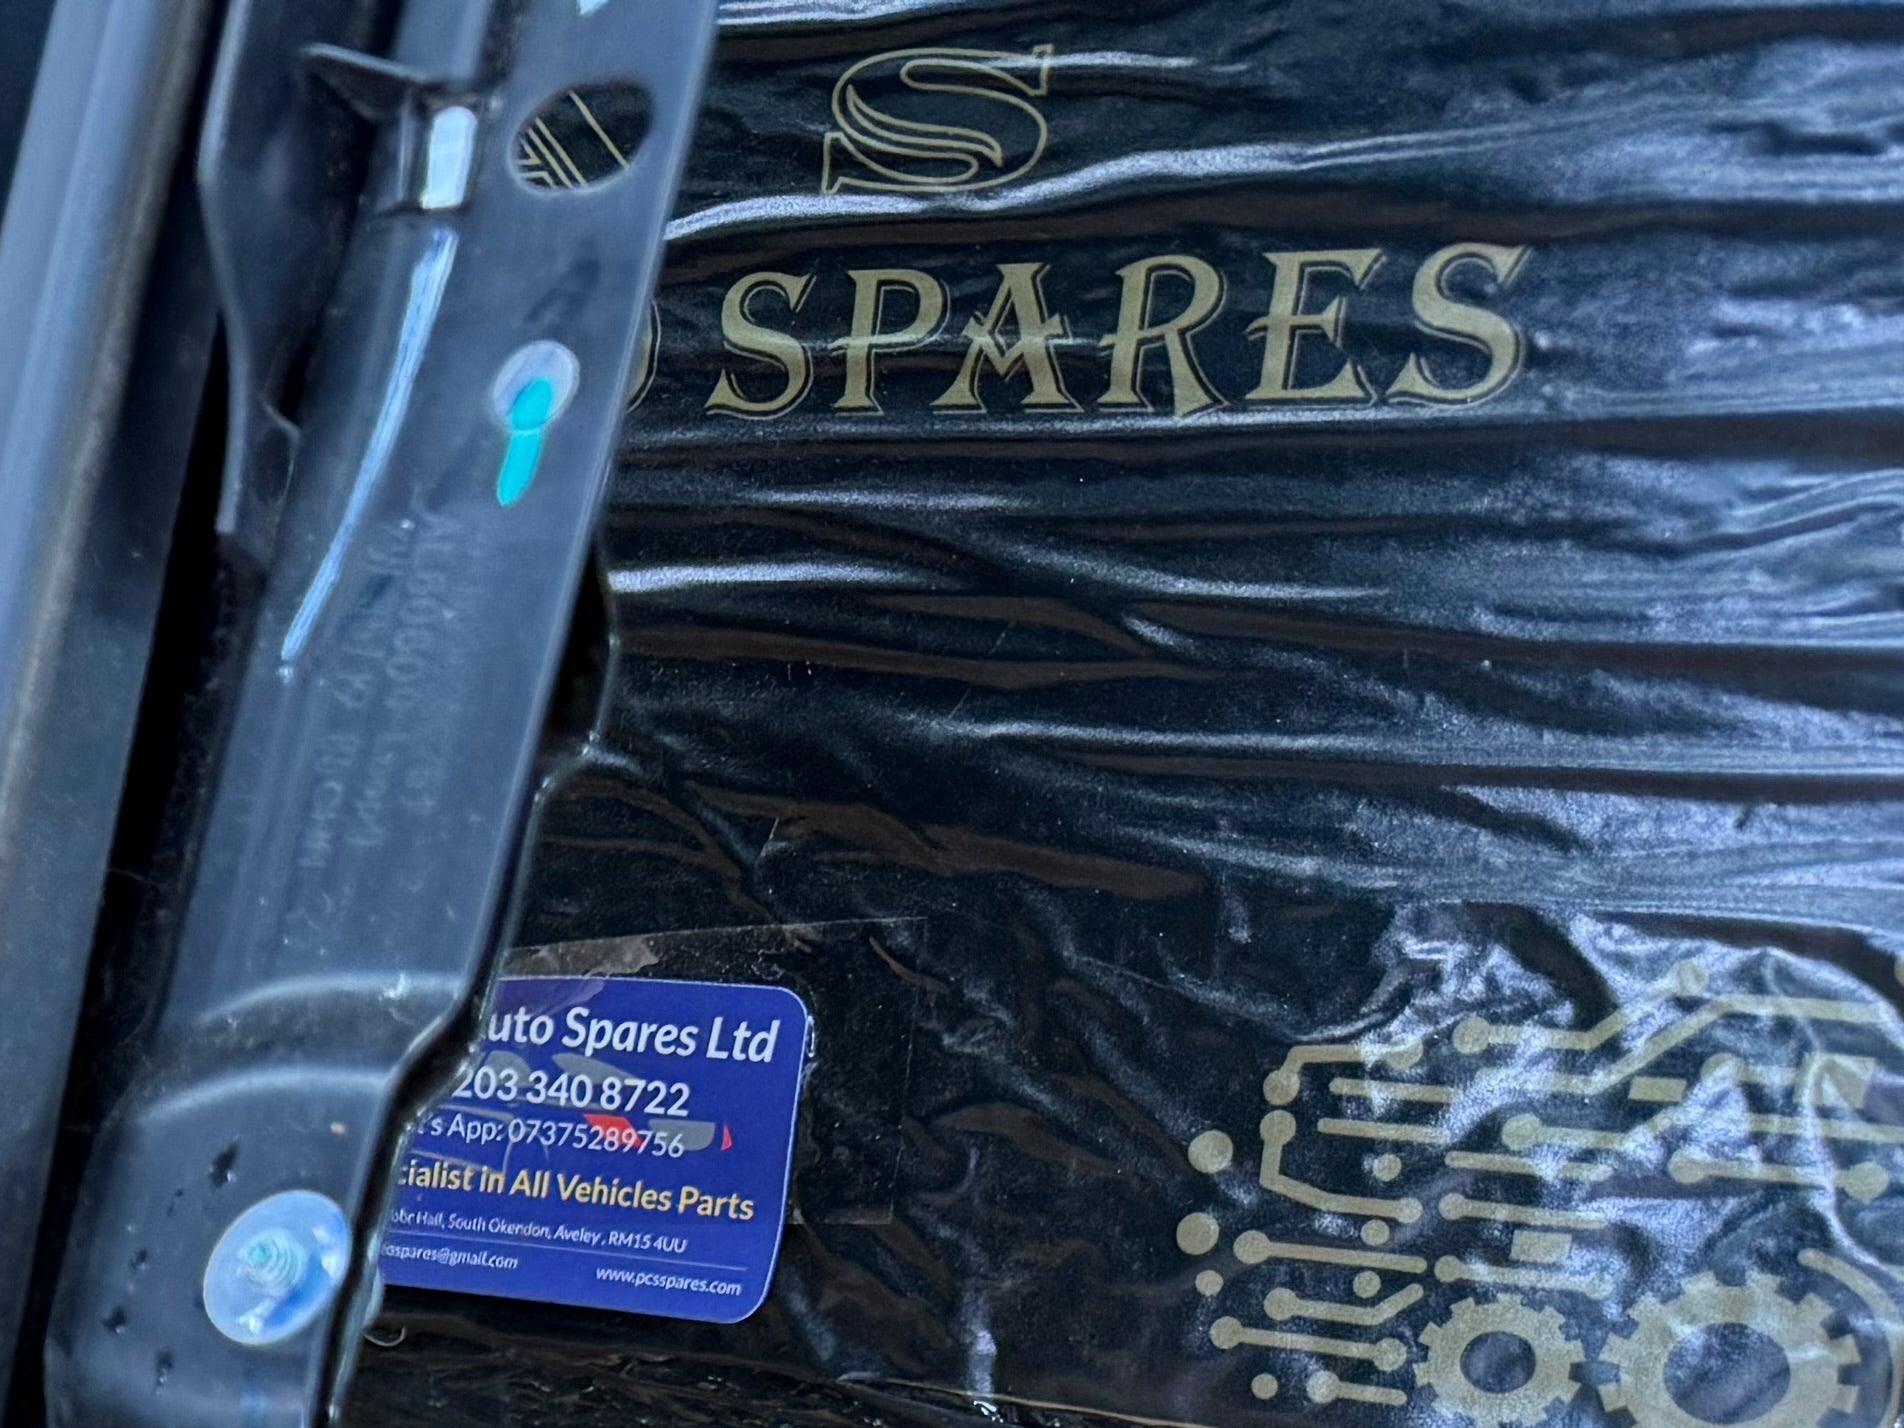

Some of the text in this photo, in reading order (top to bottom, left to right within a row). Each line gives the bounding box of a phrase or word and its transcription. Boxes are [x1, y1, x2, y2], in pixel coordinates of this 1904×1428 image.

[704, 242, 1534, 420] SPARES
[482, 1006, 781, 1064] uto Spares Ltd
[526, 1070, 593, 1108] 340
[600, 1076, 690, 1117] 8722
[447, 1113, 503, 1144] App:
[508, 1118, 685, 1158] 07375289756
[479, 1165, 506, 1194] in
[509, 1169, 551, 1199] All
[556, 1172, 672, 1213] Vehicles
[677, 1186, 755, 1221] Parts
[448, 1213, 486, 1232] South
[608, 1231, 652, 1250] RM15
[596, 1267, 742, 1297] www.pcsspares.com
